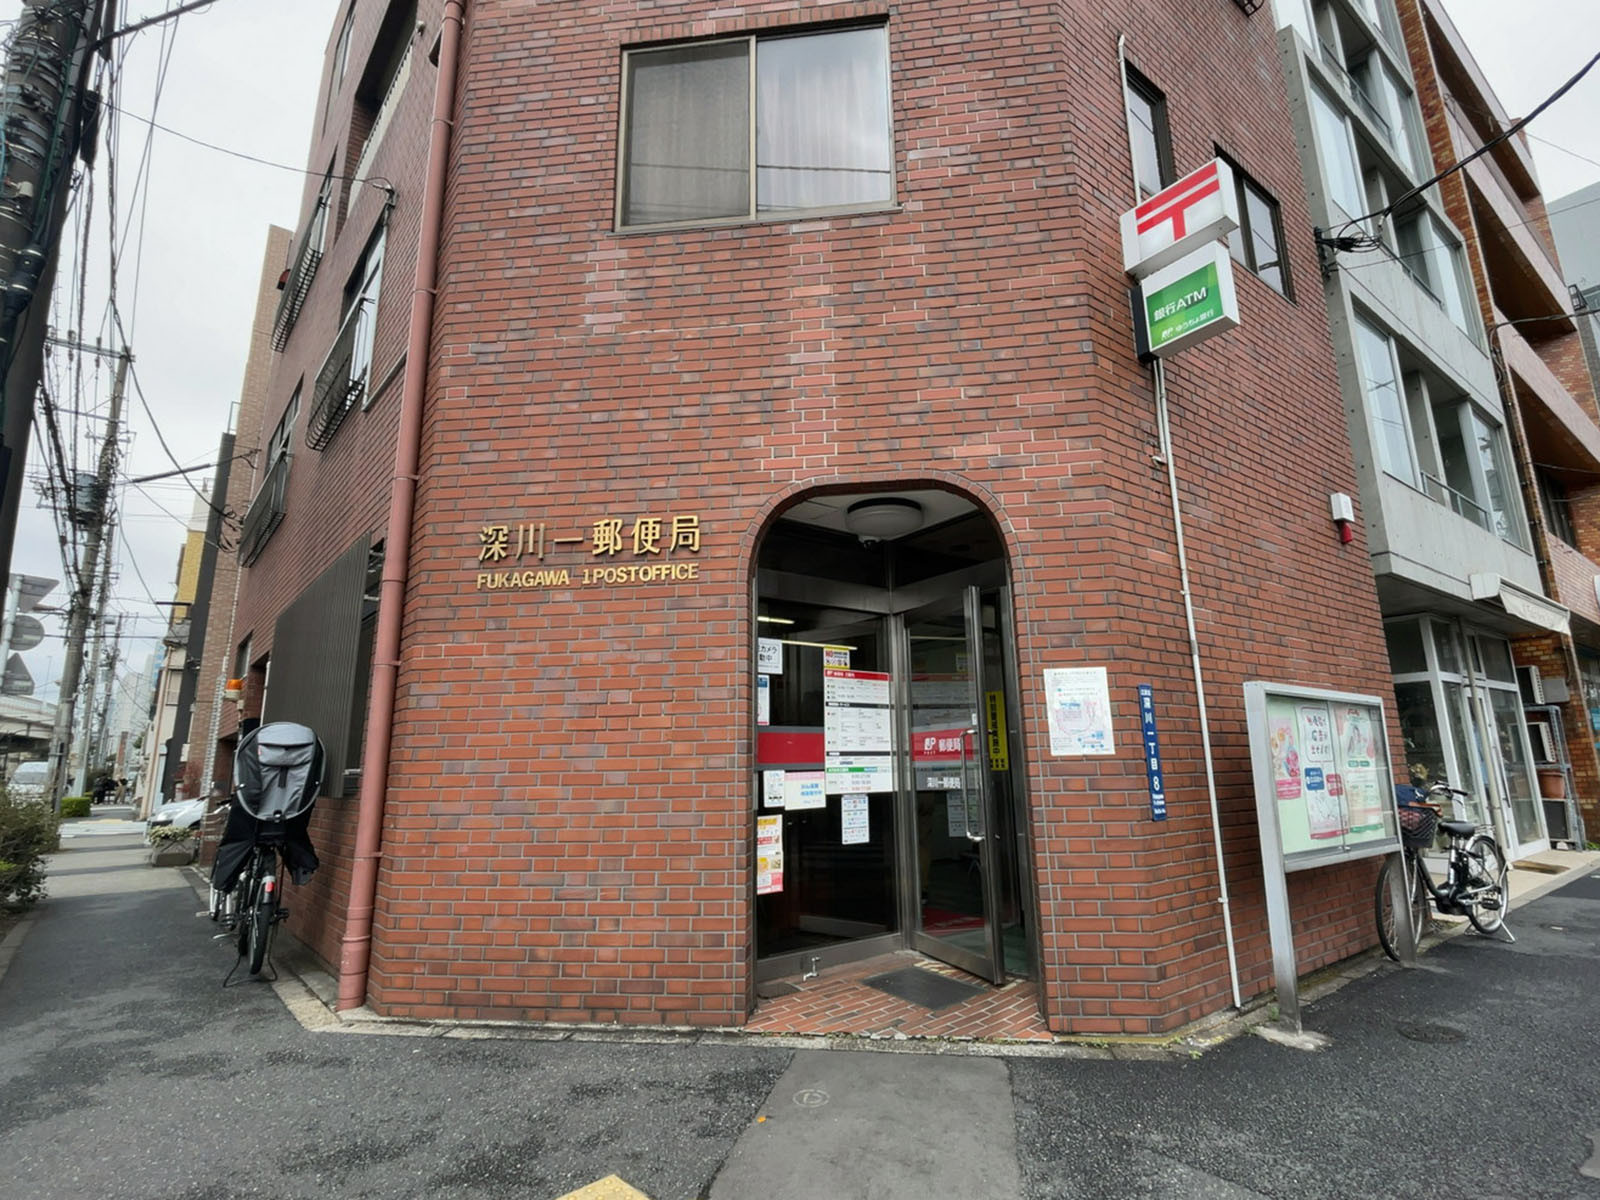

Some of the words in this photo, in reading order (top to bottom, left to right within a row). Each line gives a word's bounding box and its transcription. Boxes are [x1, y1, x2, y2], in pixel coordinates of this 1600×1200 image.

[1154, 287, 1207, 322] 銀行ATM
[1175, 308, 1214, 332] ゆうちょ銀行
[478, 514, 701, 562] 深川一郵便局
[477, 570, 570, 589] FUKAGAWA
